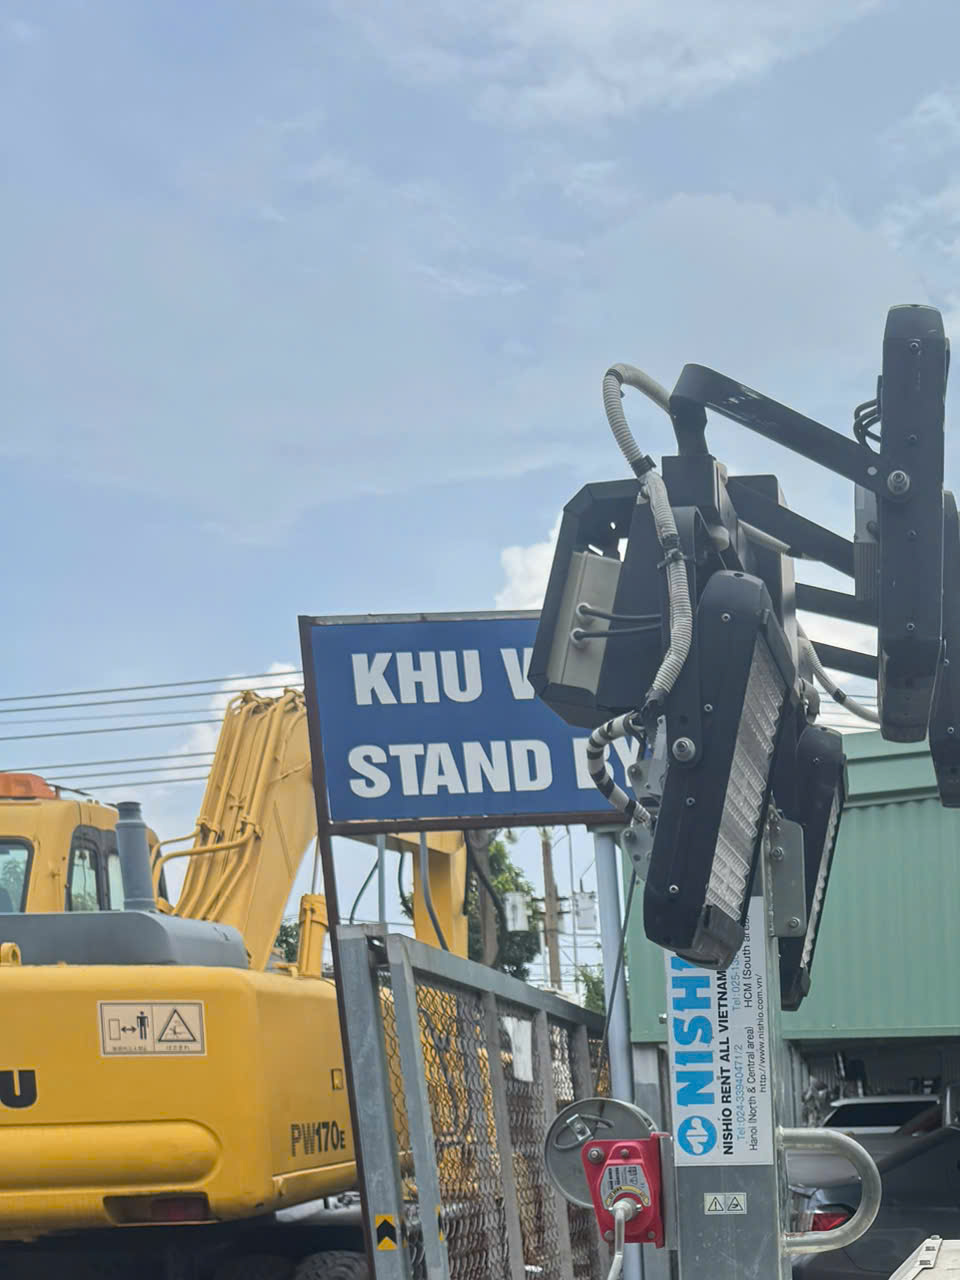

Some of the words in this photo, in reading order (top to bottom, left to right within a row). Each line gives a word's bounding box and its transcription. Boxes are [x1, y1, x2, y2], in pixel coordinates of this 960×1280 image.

[352, 649, 483, 705] KHU
[348, 739, 553, 798] STAND
[742, 945, 752, 980] (South
[717, 970, 729, 1033] VIETNAM
[744, 983, 753, 1008] HCM
[719, 1037, 730, 1062] ALL
[745, 1026, 755, 1047] area)
[746, 1052, 756, 1084] Central
[720, 1067, 732, 1103] RENT
[748, 1096, 757, 1125] (North
[722, 1108, 733, 1155] NISHIO
[749, 1126, 758, 1151] Hanoi
